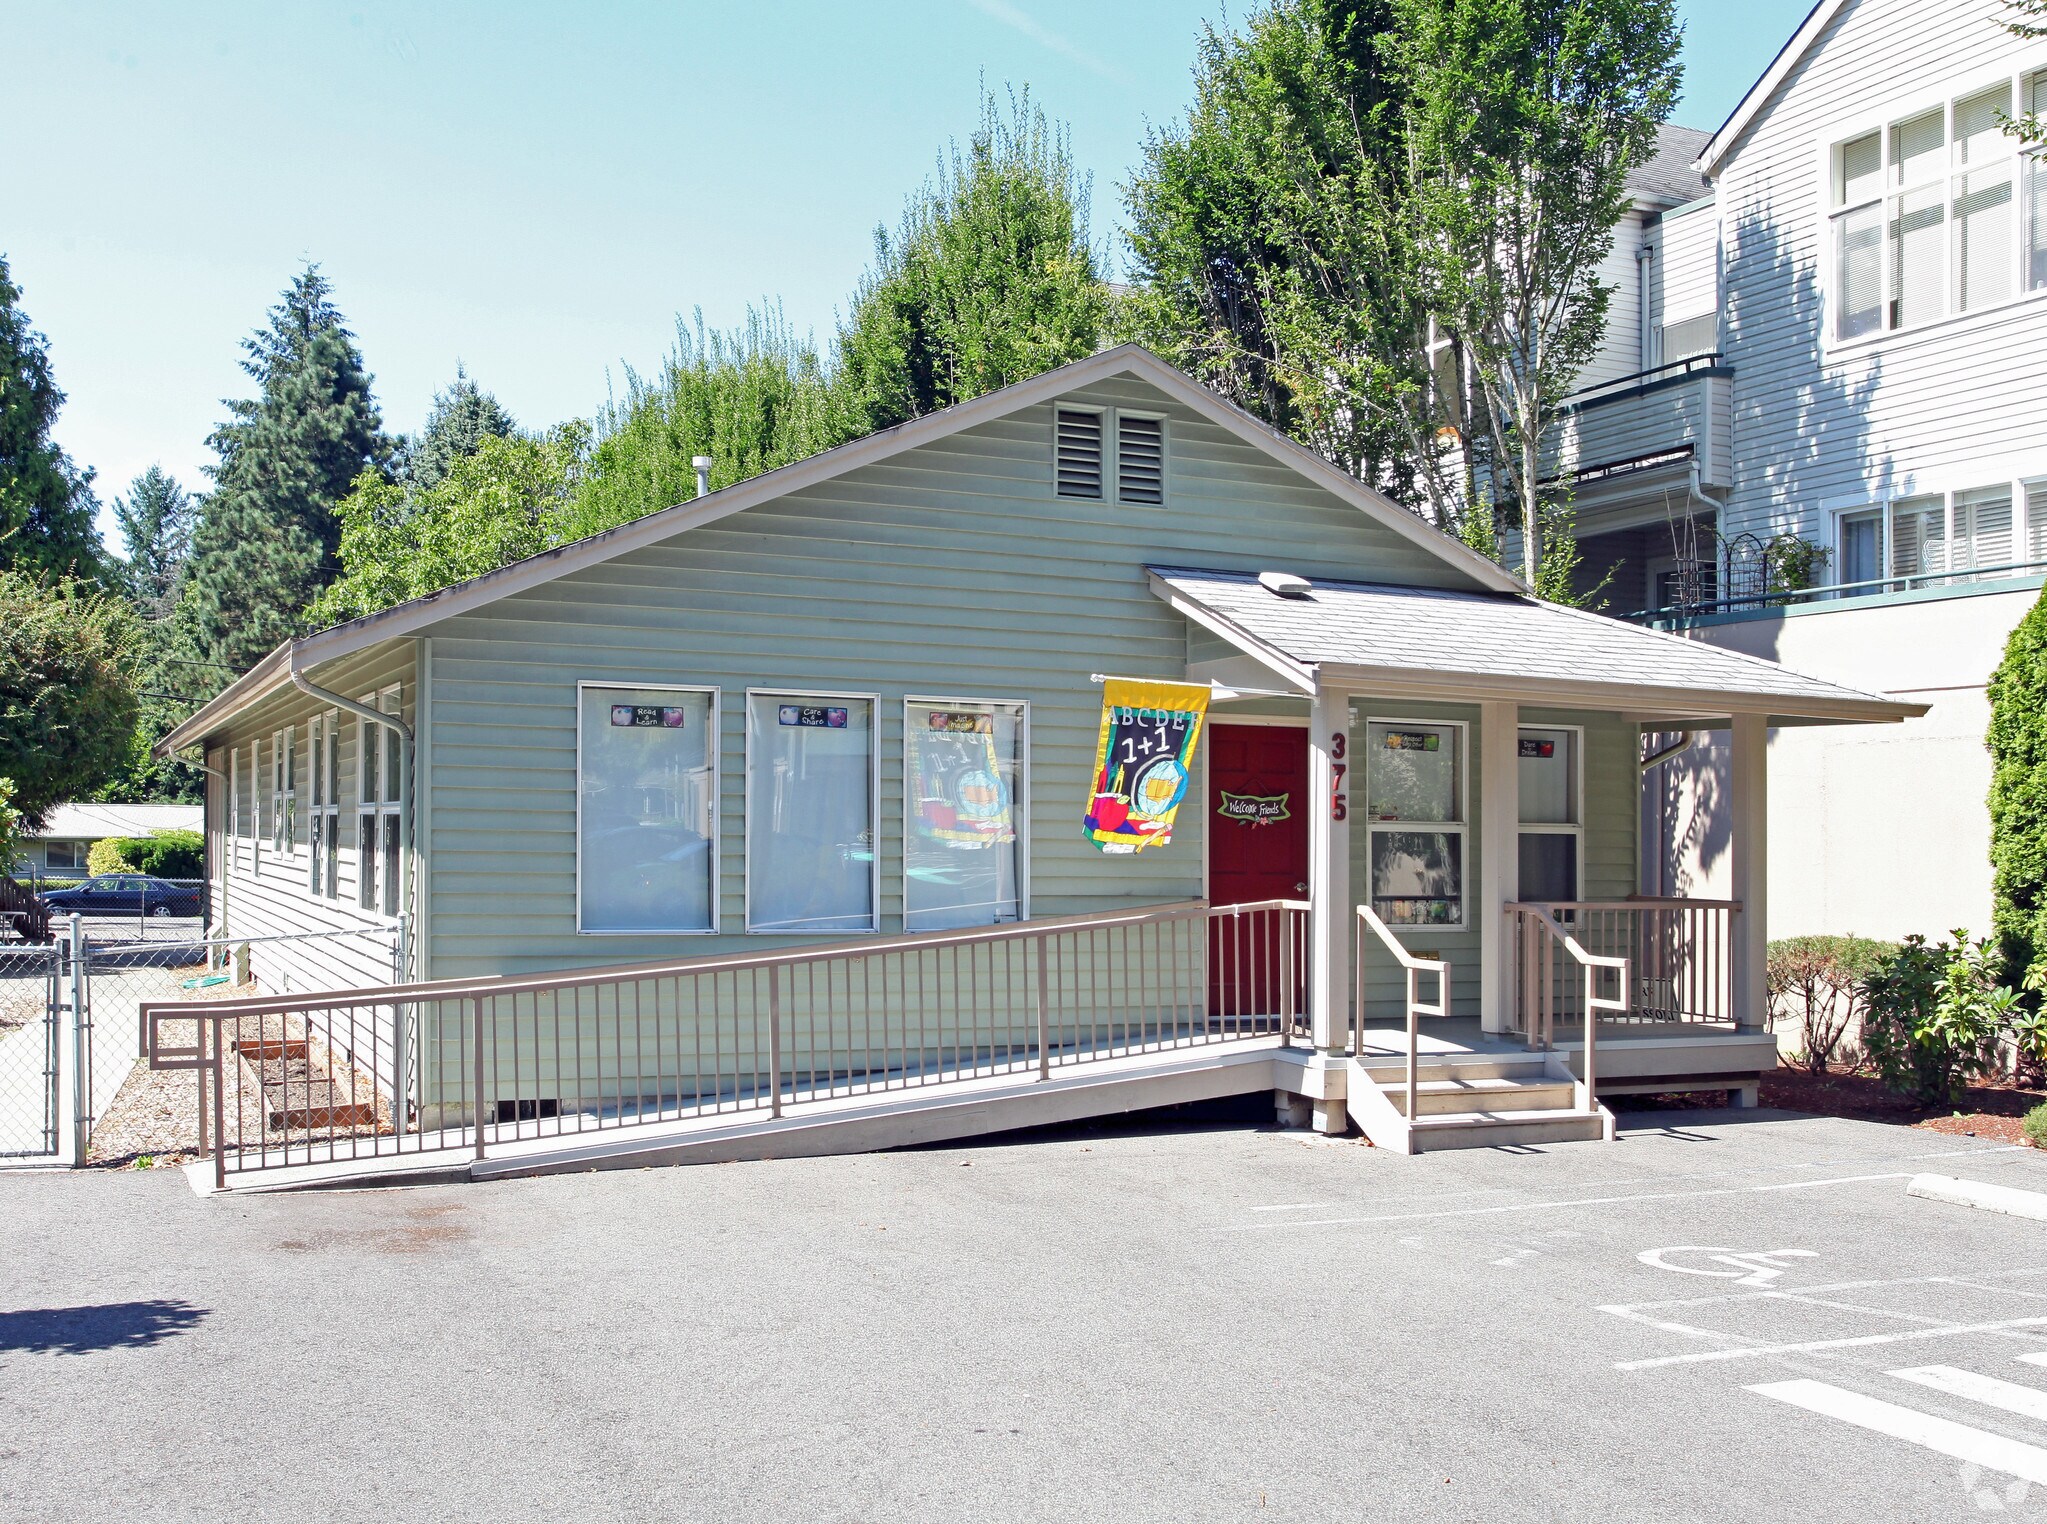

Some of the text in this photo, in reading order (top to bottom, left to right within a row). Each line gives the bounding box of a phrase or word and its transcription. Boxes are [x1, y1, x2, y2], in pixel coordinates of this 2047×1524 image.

[637, 708, 656, 716] Read
[803, 708, 821, 716] Care
[1104, 705, 1199, 731] ABCDEF
[636, 717, 658, 725] Learn
[802, 716, 824, 725] Share
[1121, 726, 1171, 764] 1+1
[1331, 732, 1347, 821] 375
[1229, 800, 1280, 816] Welcome Friends
